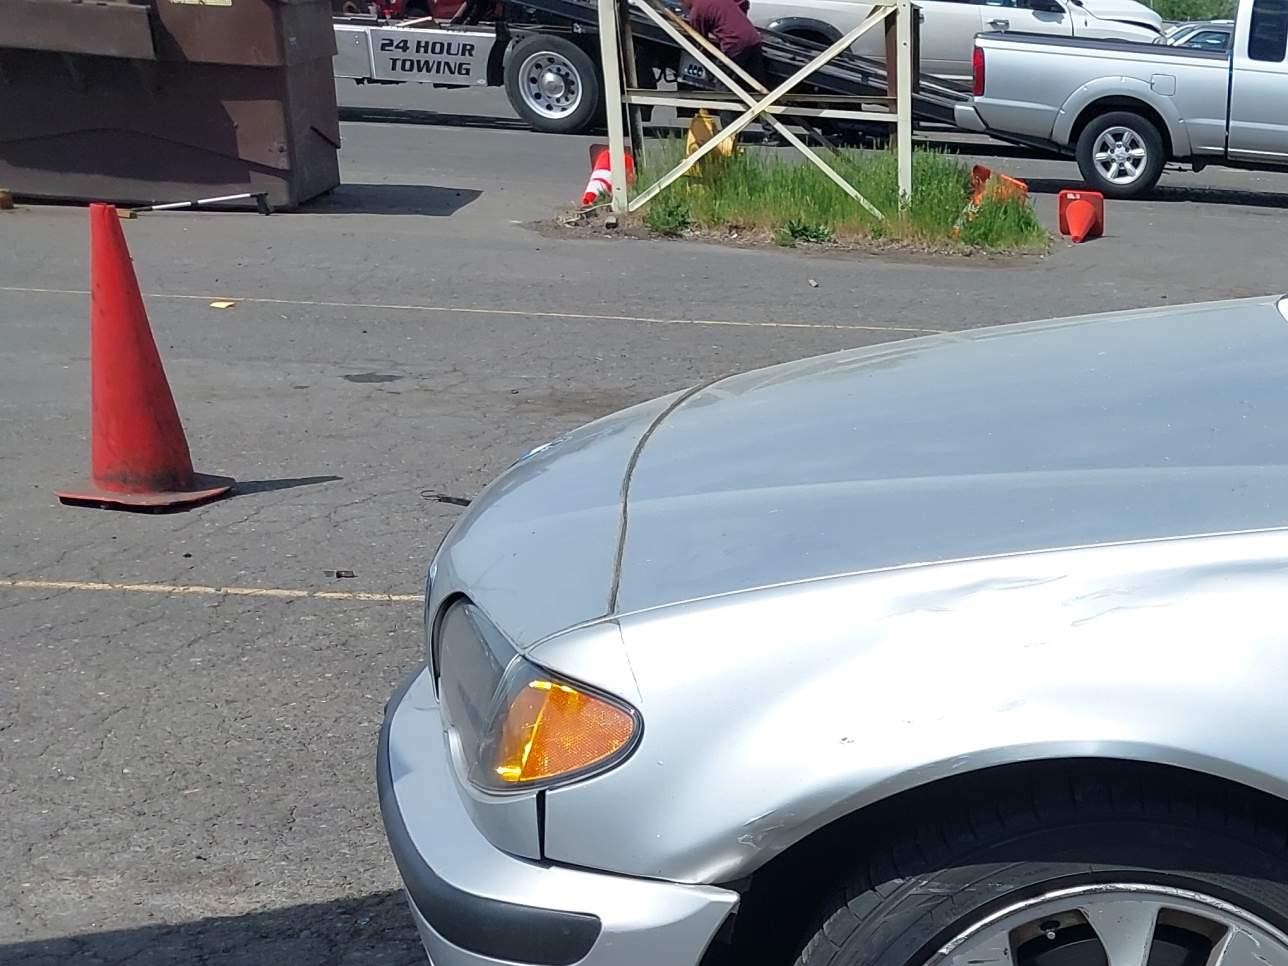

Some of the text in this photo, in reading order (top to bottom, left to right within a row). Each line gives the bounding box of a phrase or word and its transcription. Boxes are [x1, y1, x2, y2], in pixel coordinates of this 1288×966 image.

[380, 38, 475, 57] 24 HOUR
[389, 57, 472, 76] TOWING
